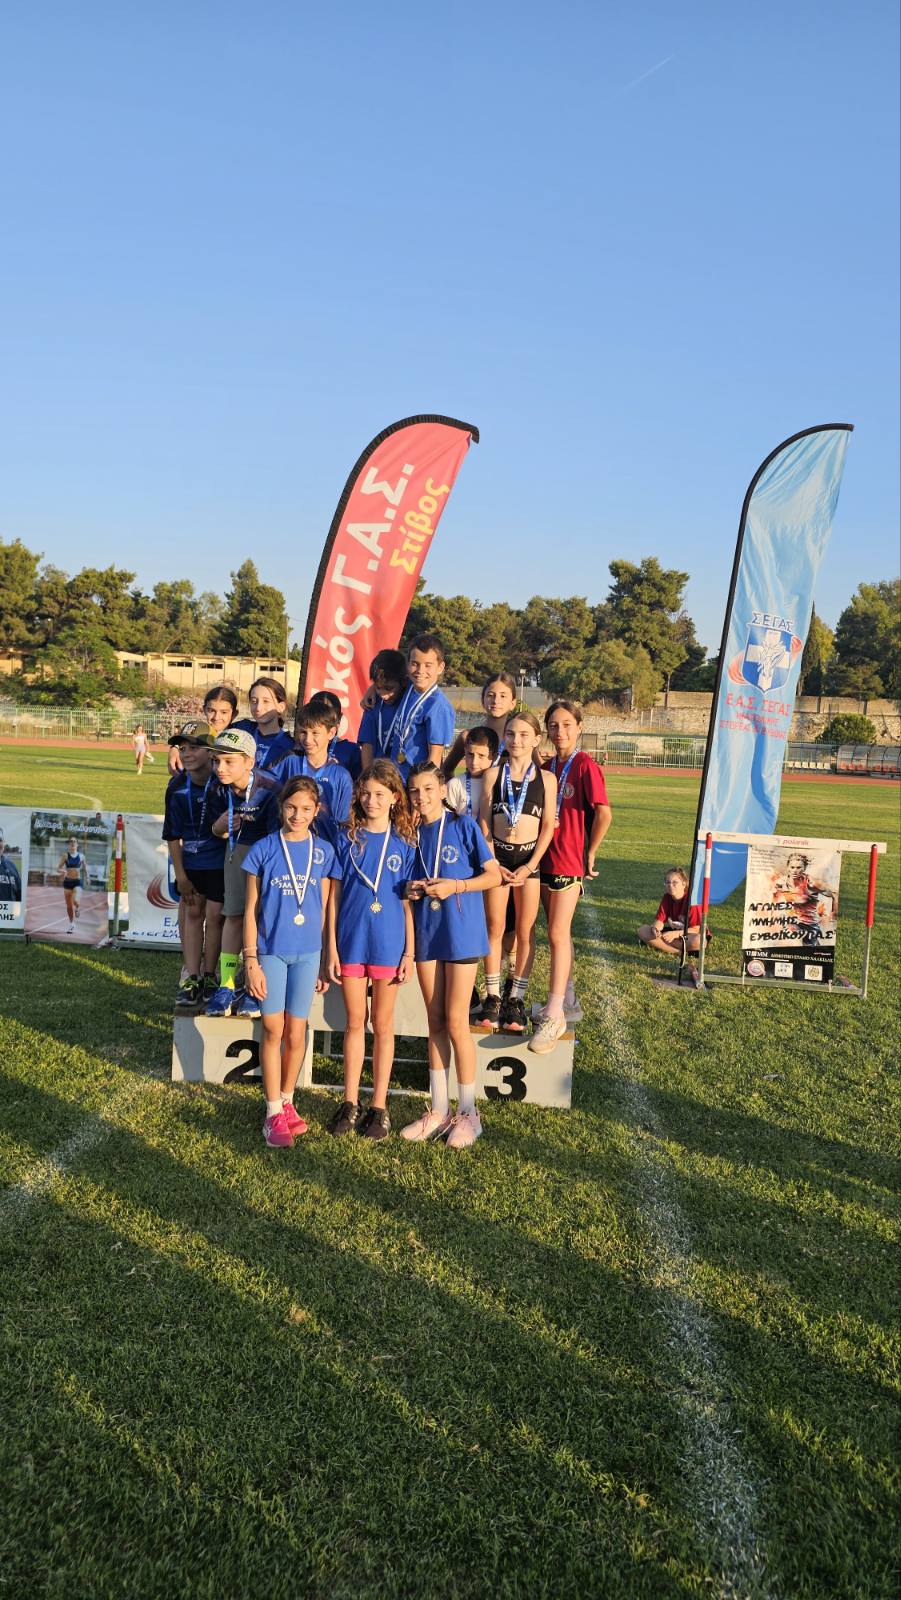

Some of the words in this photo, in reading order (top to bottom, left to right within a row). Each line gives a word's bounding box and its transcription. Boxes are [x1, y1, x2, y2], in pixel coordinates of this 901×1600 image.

[331, 463, 415, 594] Γ.Α.Σ.
[389, 477, 450, 576] Στίβος
[752, 612, 794, 632] ΣΕΓΑΣ
[748, 901, 793, 912] ΑΓΩΝΕΣ
[223, 1039, 263, 1084] 2
[483, 1056, 527, 1101] 3
